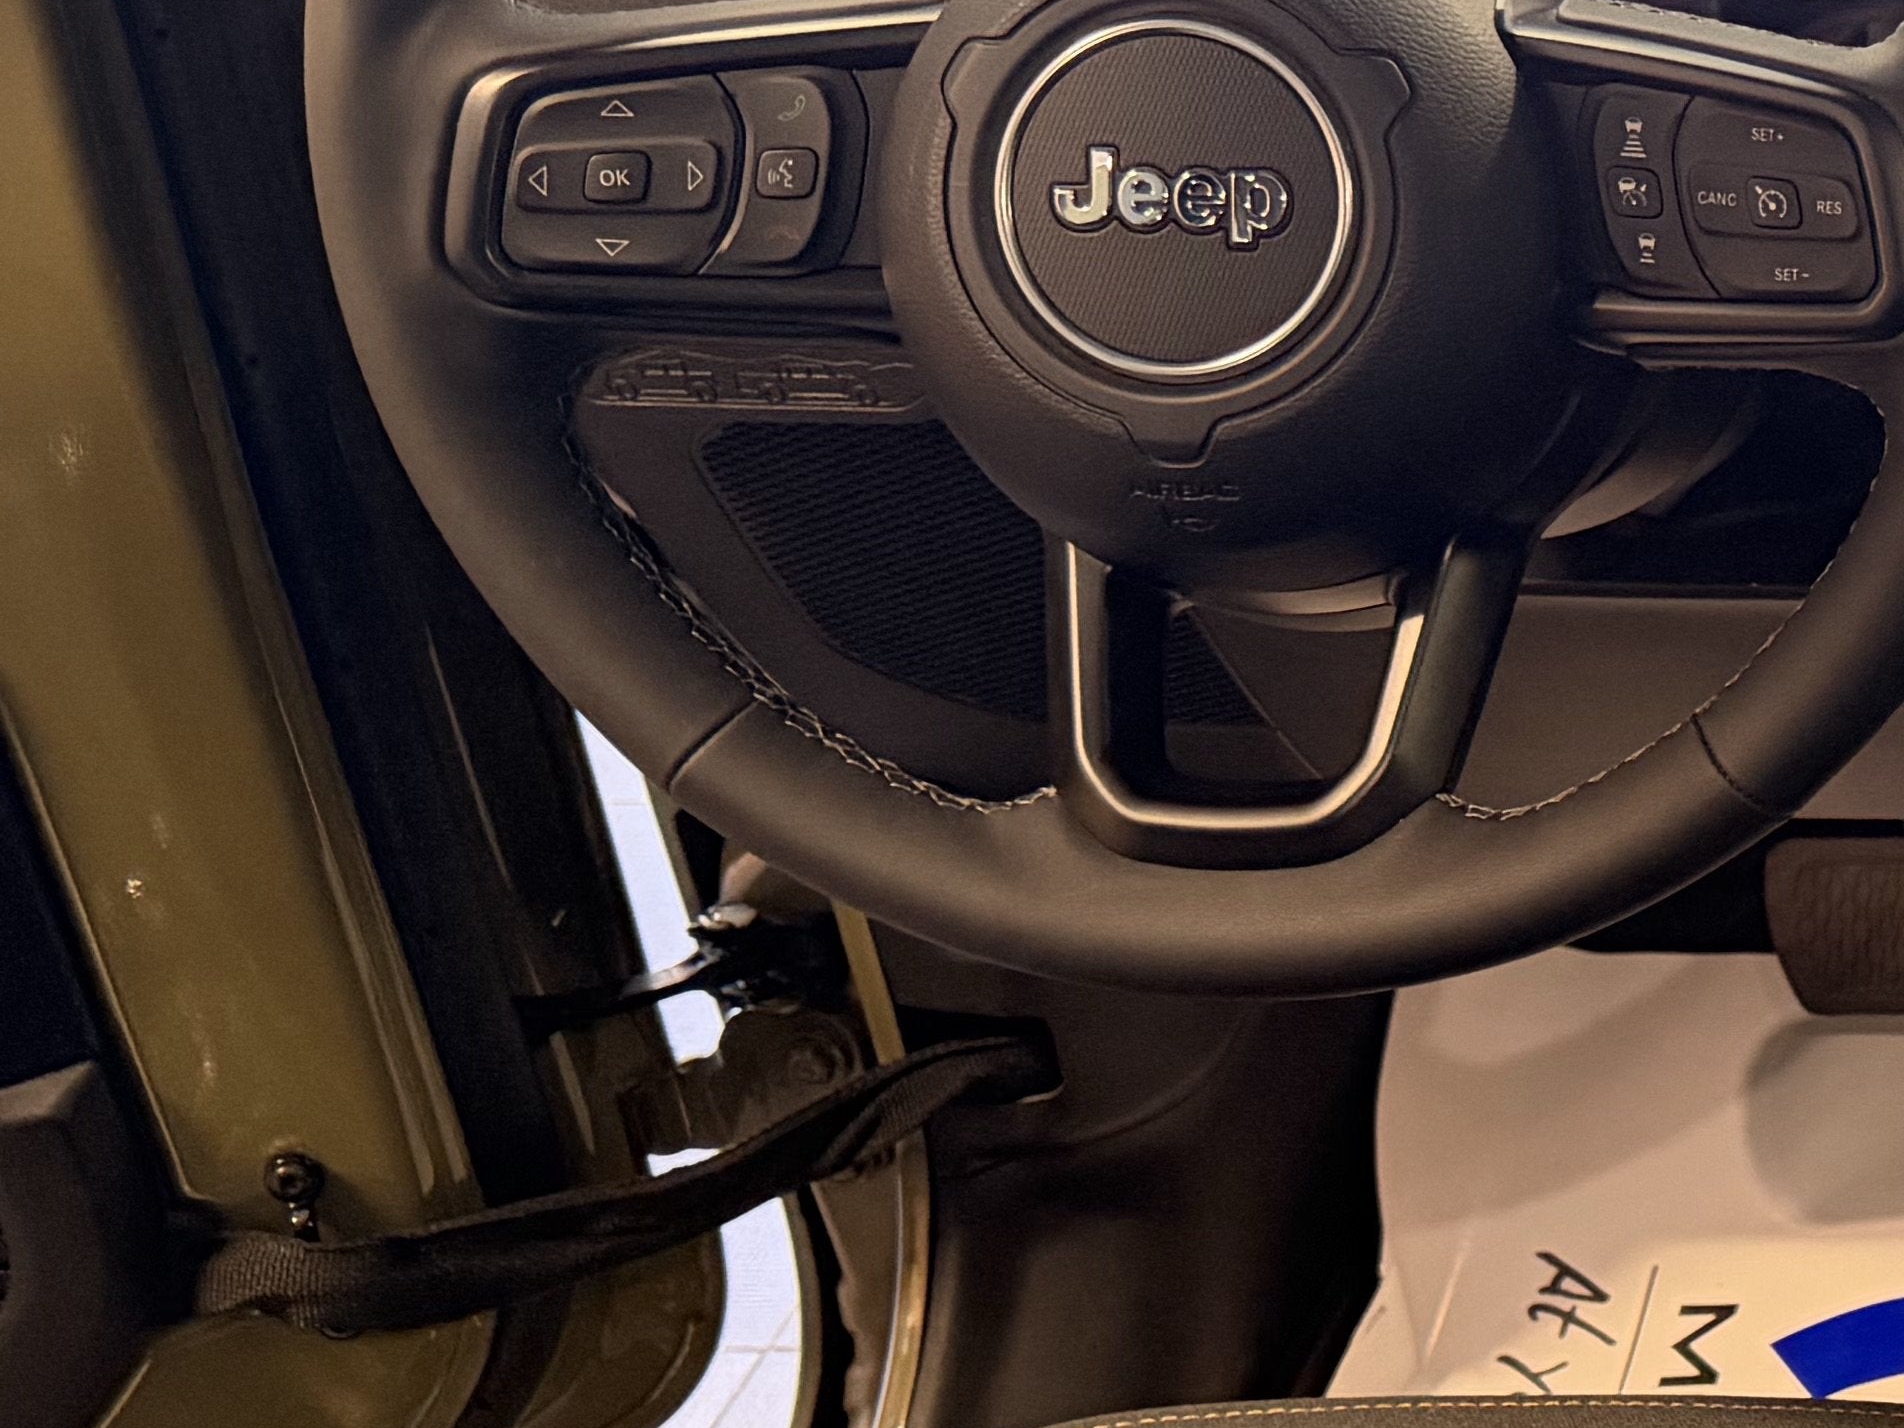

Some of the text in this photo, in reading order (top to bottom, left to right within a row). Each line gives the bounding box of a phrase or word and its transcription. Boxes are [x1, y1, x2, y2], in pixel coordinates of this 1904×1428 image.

[599, 169, 631, 187] OK
[1051, 144, 1292, 247] Jeep
[1697, 190, 1737, 209] CANC
[1815, 199, 1842, 217] RES
